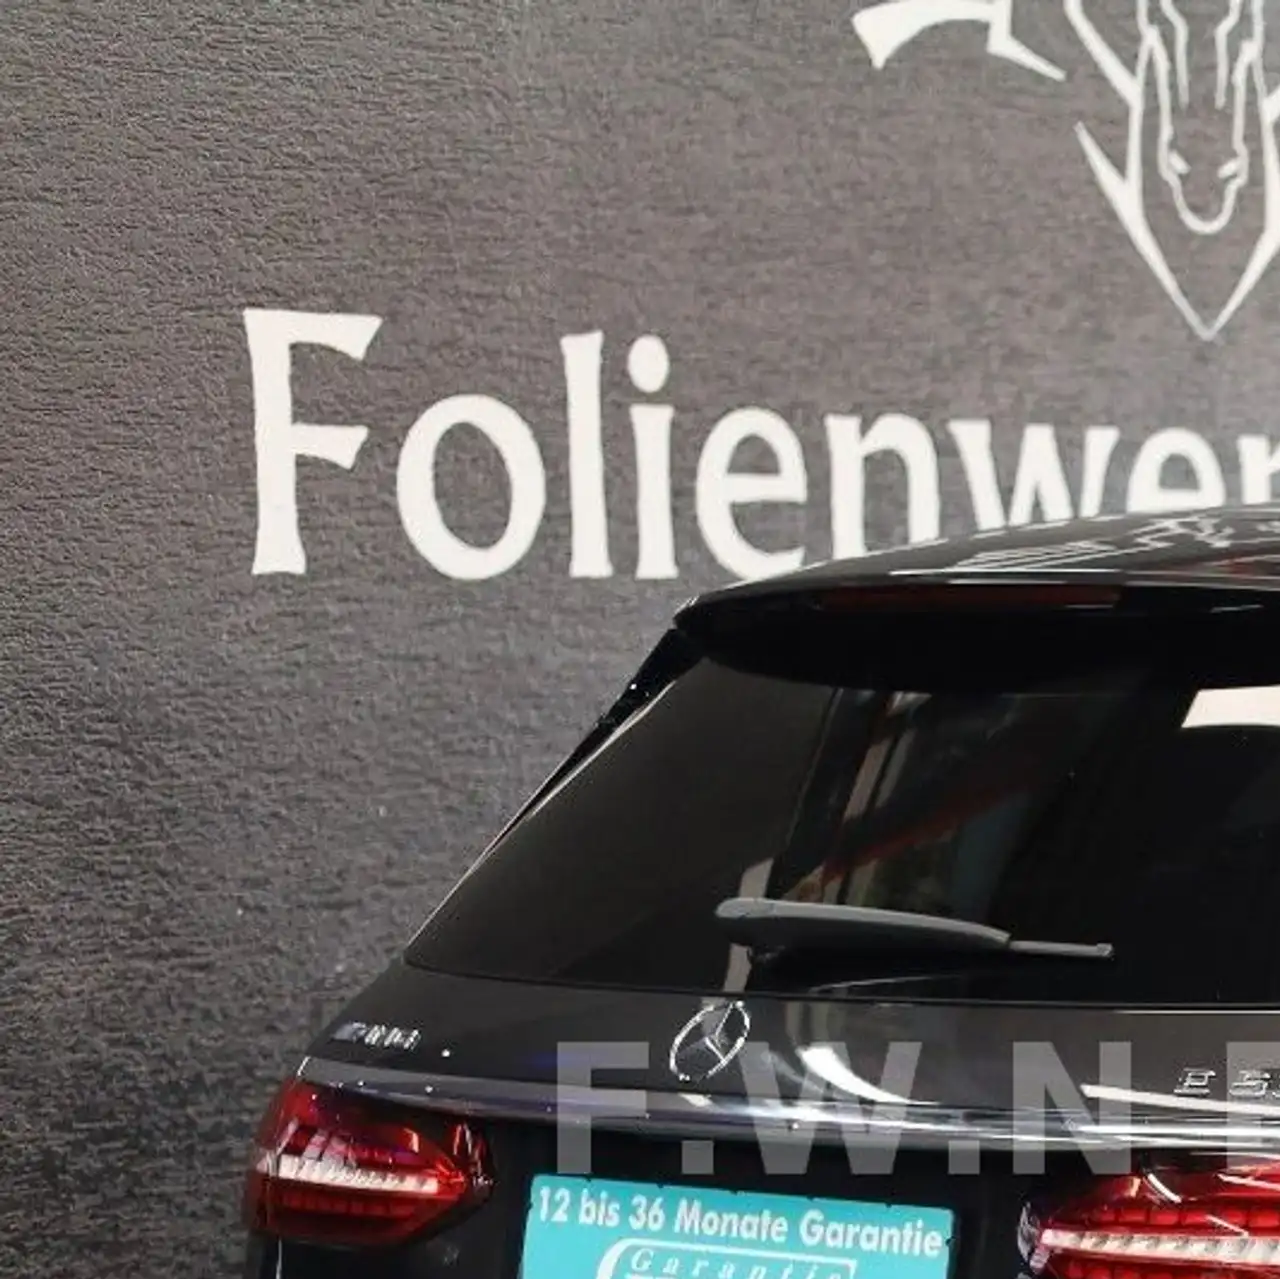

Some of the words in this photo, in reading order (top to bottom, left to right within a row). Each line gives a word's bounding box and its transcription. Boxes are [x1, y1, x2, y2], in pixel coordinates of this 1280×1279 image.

[539, 1186, 572, 1224] 12
[578, 1189, 621, 1228] bis
[628, 1194, 666, 1232] 36
[674, 1198, 789, 1243] Monate
[800, 1209, 943, 1258] Garantie
